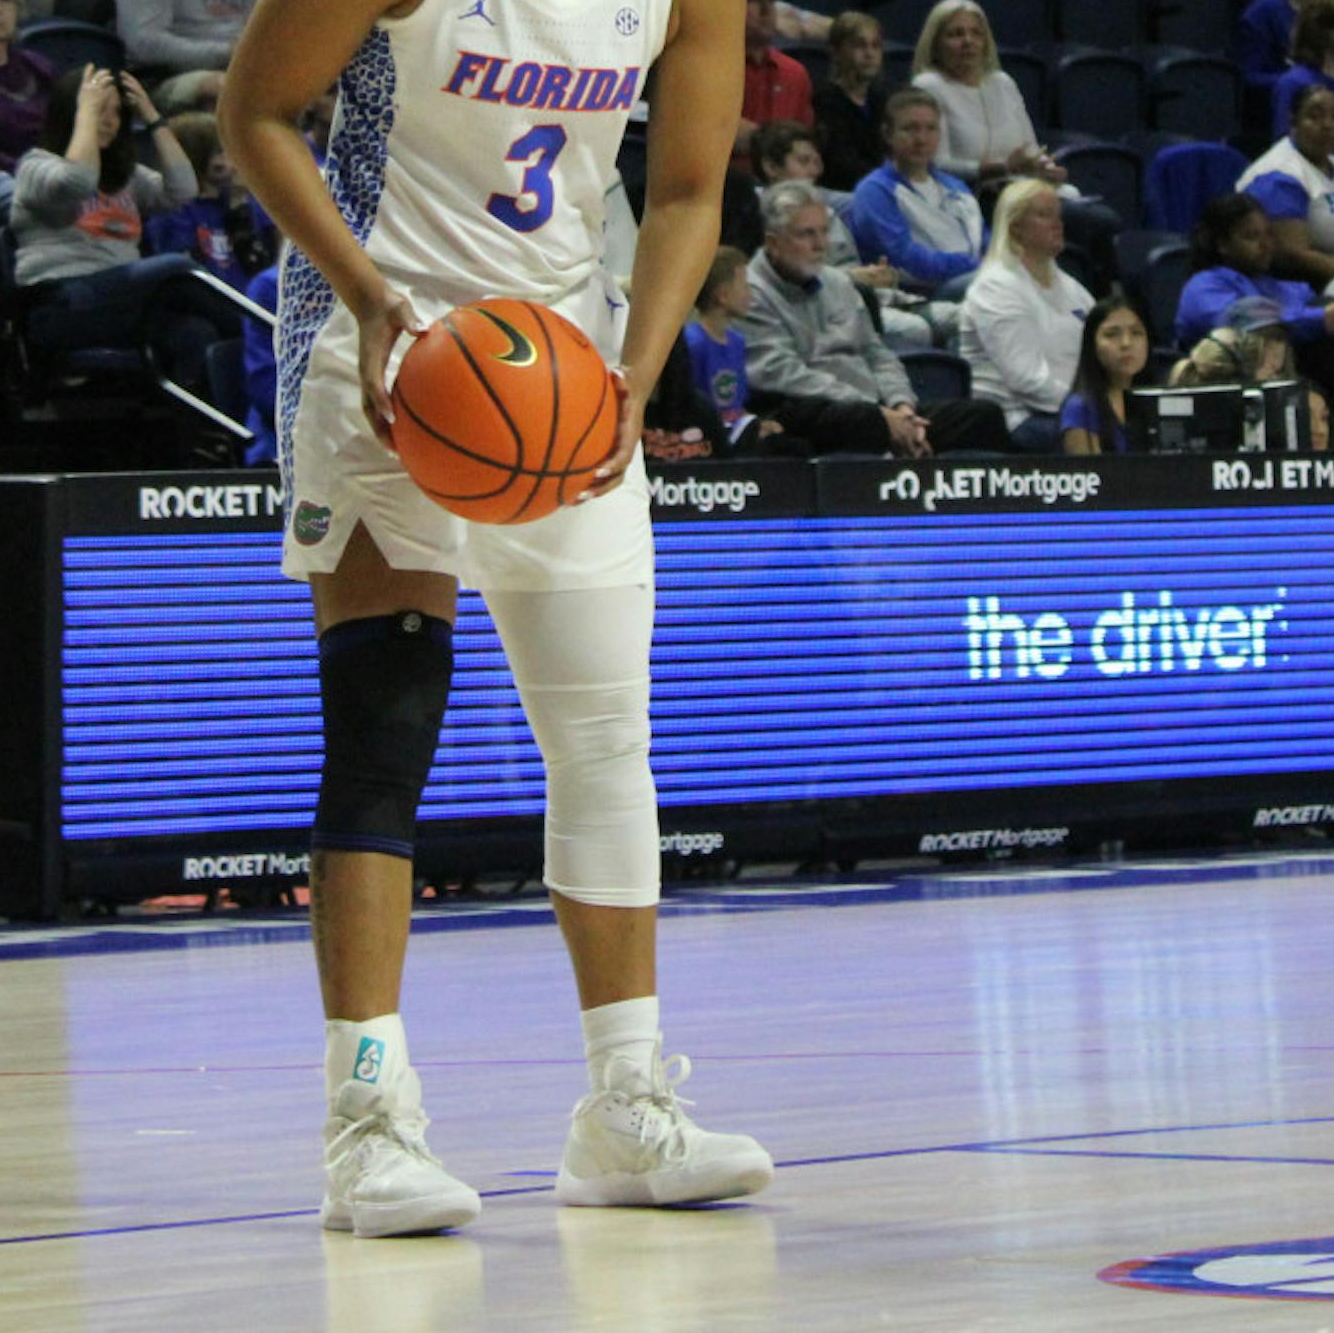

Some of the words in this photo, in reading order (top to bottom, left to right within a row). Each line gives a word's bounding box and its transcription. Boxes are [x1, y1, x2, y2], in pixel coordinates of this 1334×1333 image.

[441, 50, 641, 112] FLORIDA
[486, 123, 568, 234] 3
[140, 484, 263, 519] ROCKET
[988, 467, 1101, 504] Mortgage
[963, 596, 1073, 680] the
[1091, 589, 1275, 676] driver
[1252, 803, 1324, 828] ROCKET
[660, 831, 725, 857] ortgage
[918, 830, 994, 854] ROCKET
[184, 853, 267, 881] ROCKET
[267, 851, 311, 877] Mort
